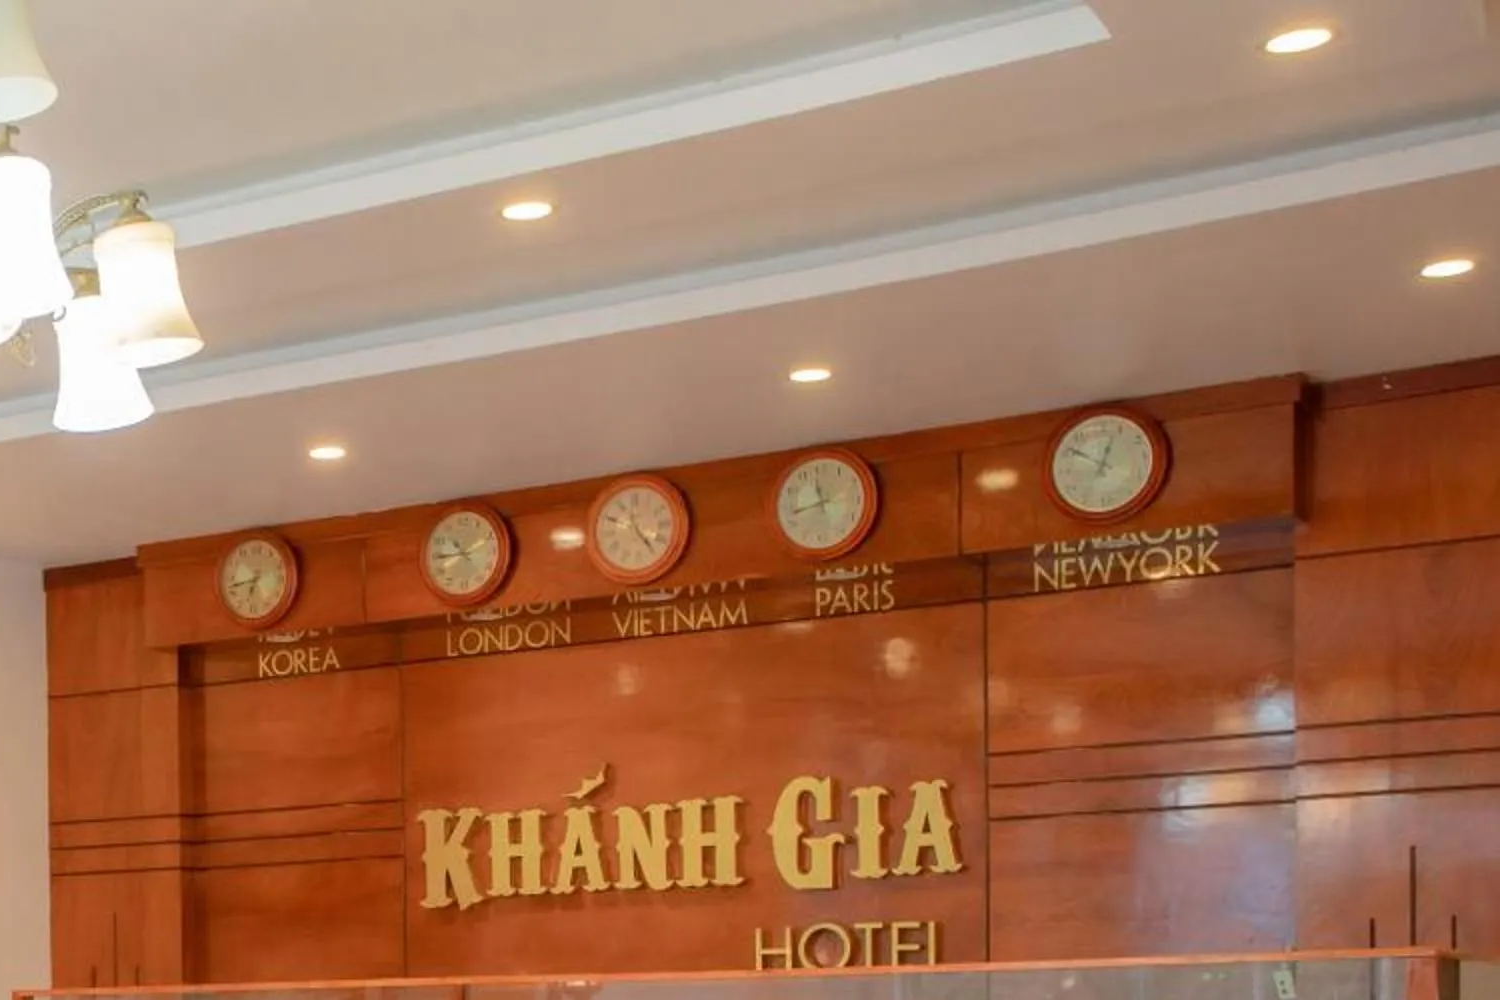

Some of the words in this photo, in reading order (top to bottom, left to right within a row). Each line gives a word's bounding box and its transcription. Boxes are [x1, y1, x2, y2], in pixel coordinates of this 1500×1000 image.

[1033, 539, 1221, 593] NEWYORK
[611, 598, 749, 638] VIETNAM
[815, 579, 896, 618] PARIS
[446, 616, 571, 657] LONDON
[259, 646, 340, 678] KOREA
[417, 762, 747, 911] KHÁNH
[766, 776, 963, 890] GIA
